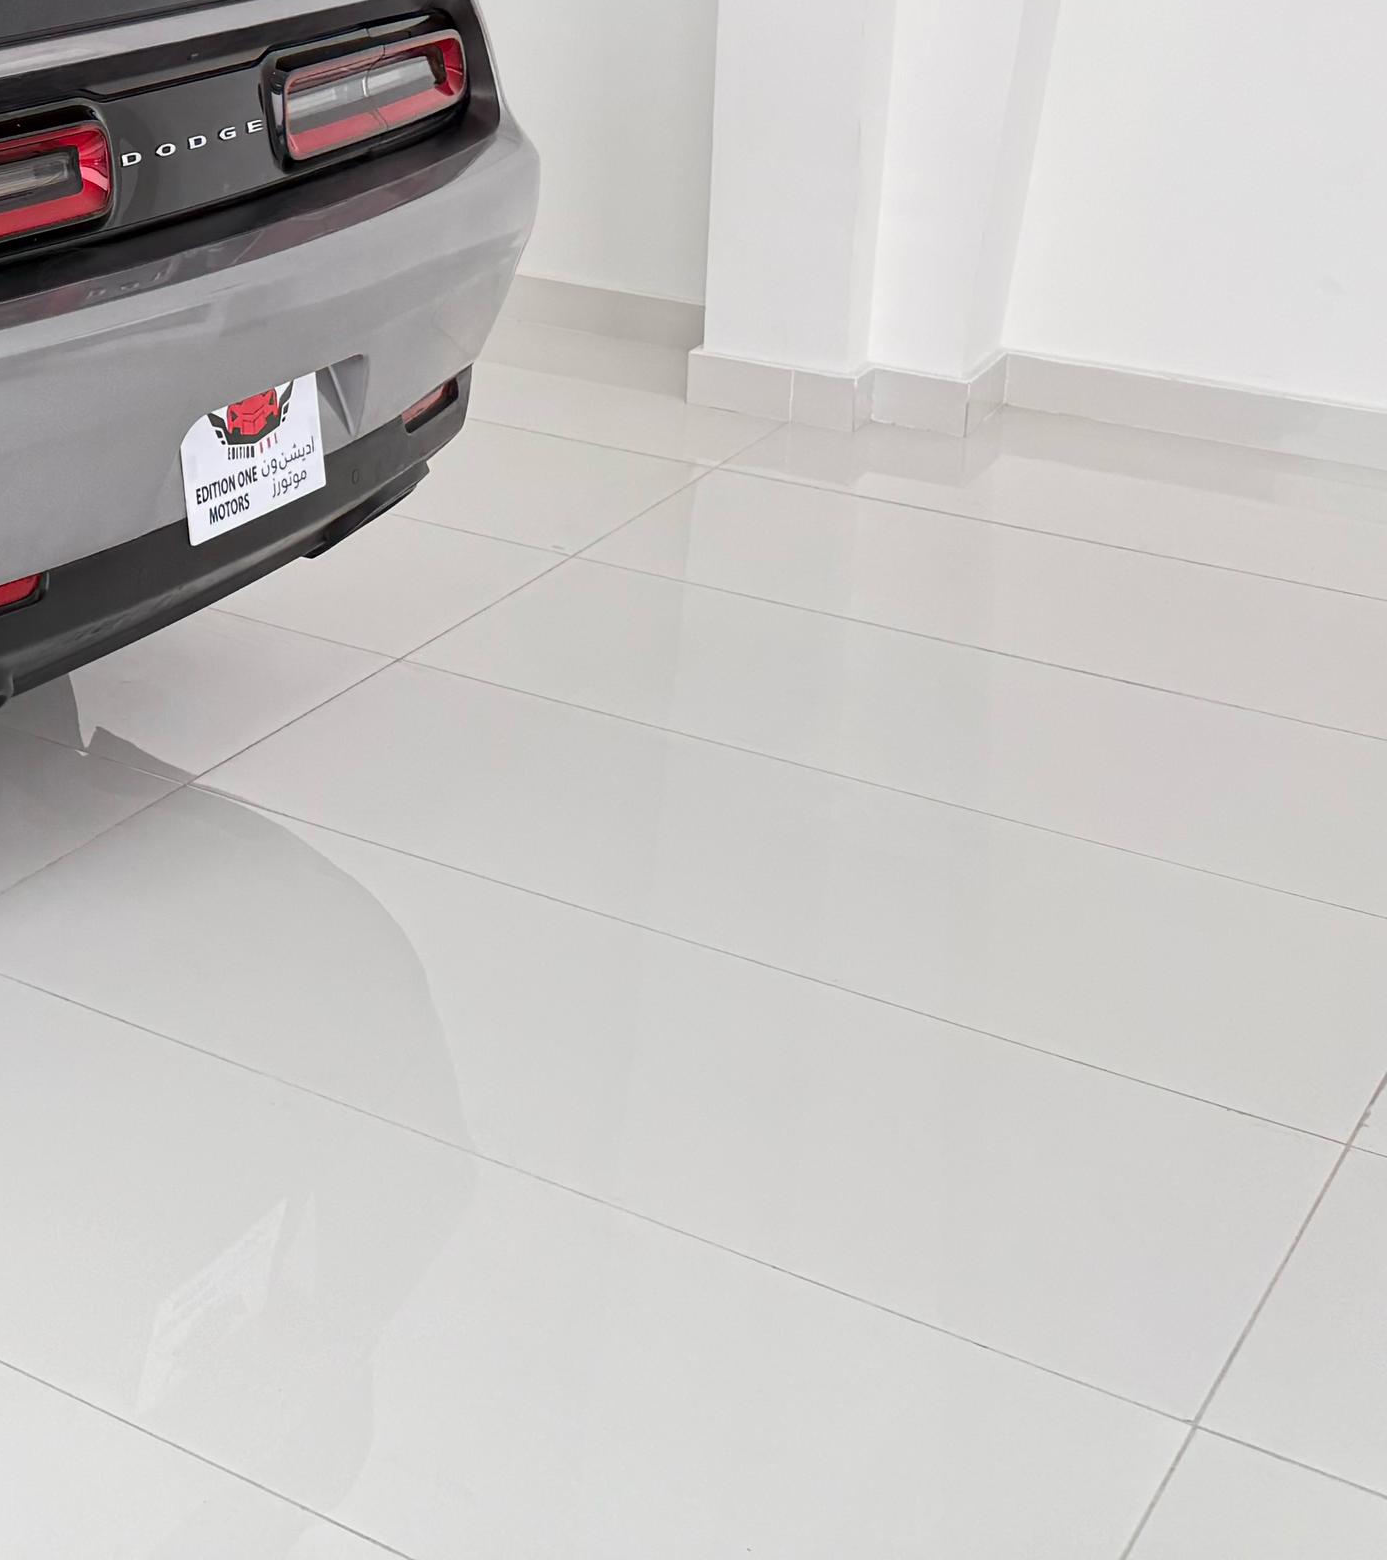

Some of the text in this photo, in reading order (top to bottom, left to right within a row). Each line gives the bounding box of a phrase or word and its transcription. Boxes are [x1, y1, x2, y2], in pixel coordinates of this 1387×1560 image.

[120, 119, 265, 168] DODGE
[227, 445, 256, 461] EDITION
[261, 457, 278, 478] ون
[279, 436, 315, 470] اديشن
[195, 465, 258, 505] EDITION ONE
[271, 468, 307, 498] موتورز
[209, 493, 250, 525] MOTORS
